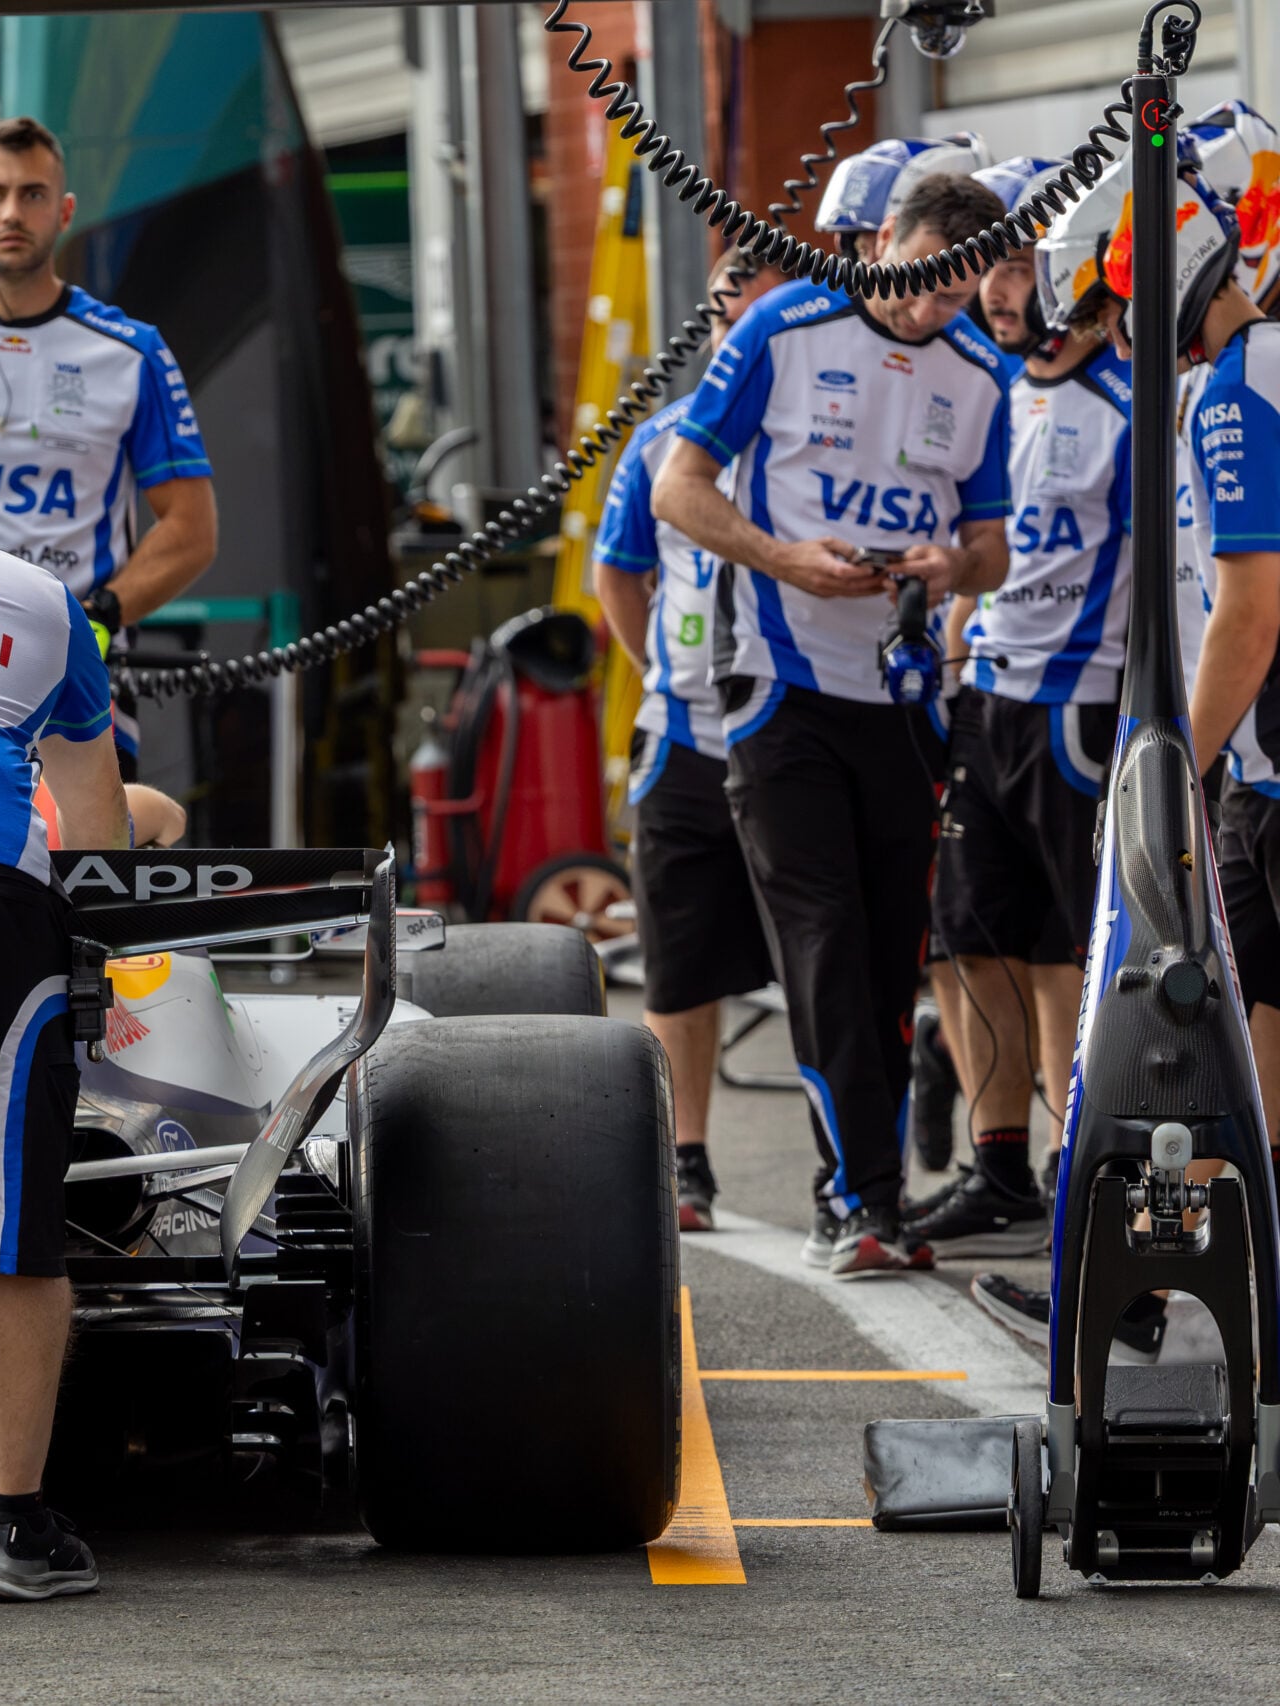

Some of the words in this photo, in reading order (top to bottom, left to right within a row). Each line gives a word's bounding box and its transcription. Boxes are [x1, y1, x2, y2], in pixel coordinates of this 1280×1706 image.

[1151, 107, 1160, 123] 1
[1181, 235, 1217, 279] OCTAVE
[780, 297, 831, 323] HUGO
[84, 311, 137, 338] HUGO
[953, 328, 999, 369] HUGO
[1199, 402, 1243, 430] VISA
[809, 432, 853, 450] Mobil
[808, 468, 938, 540] VISA
[1216, 486, 1245, 502] Bull
[1015, 504, 1085, 554] SA
[39, 545, 79, 570] App
[1039, 582, 1086, 606] App
[63, 855, 254, 901] App
